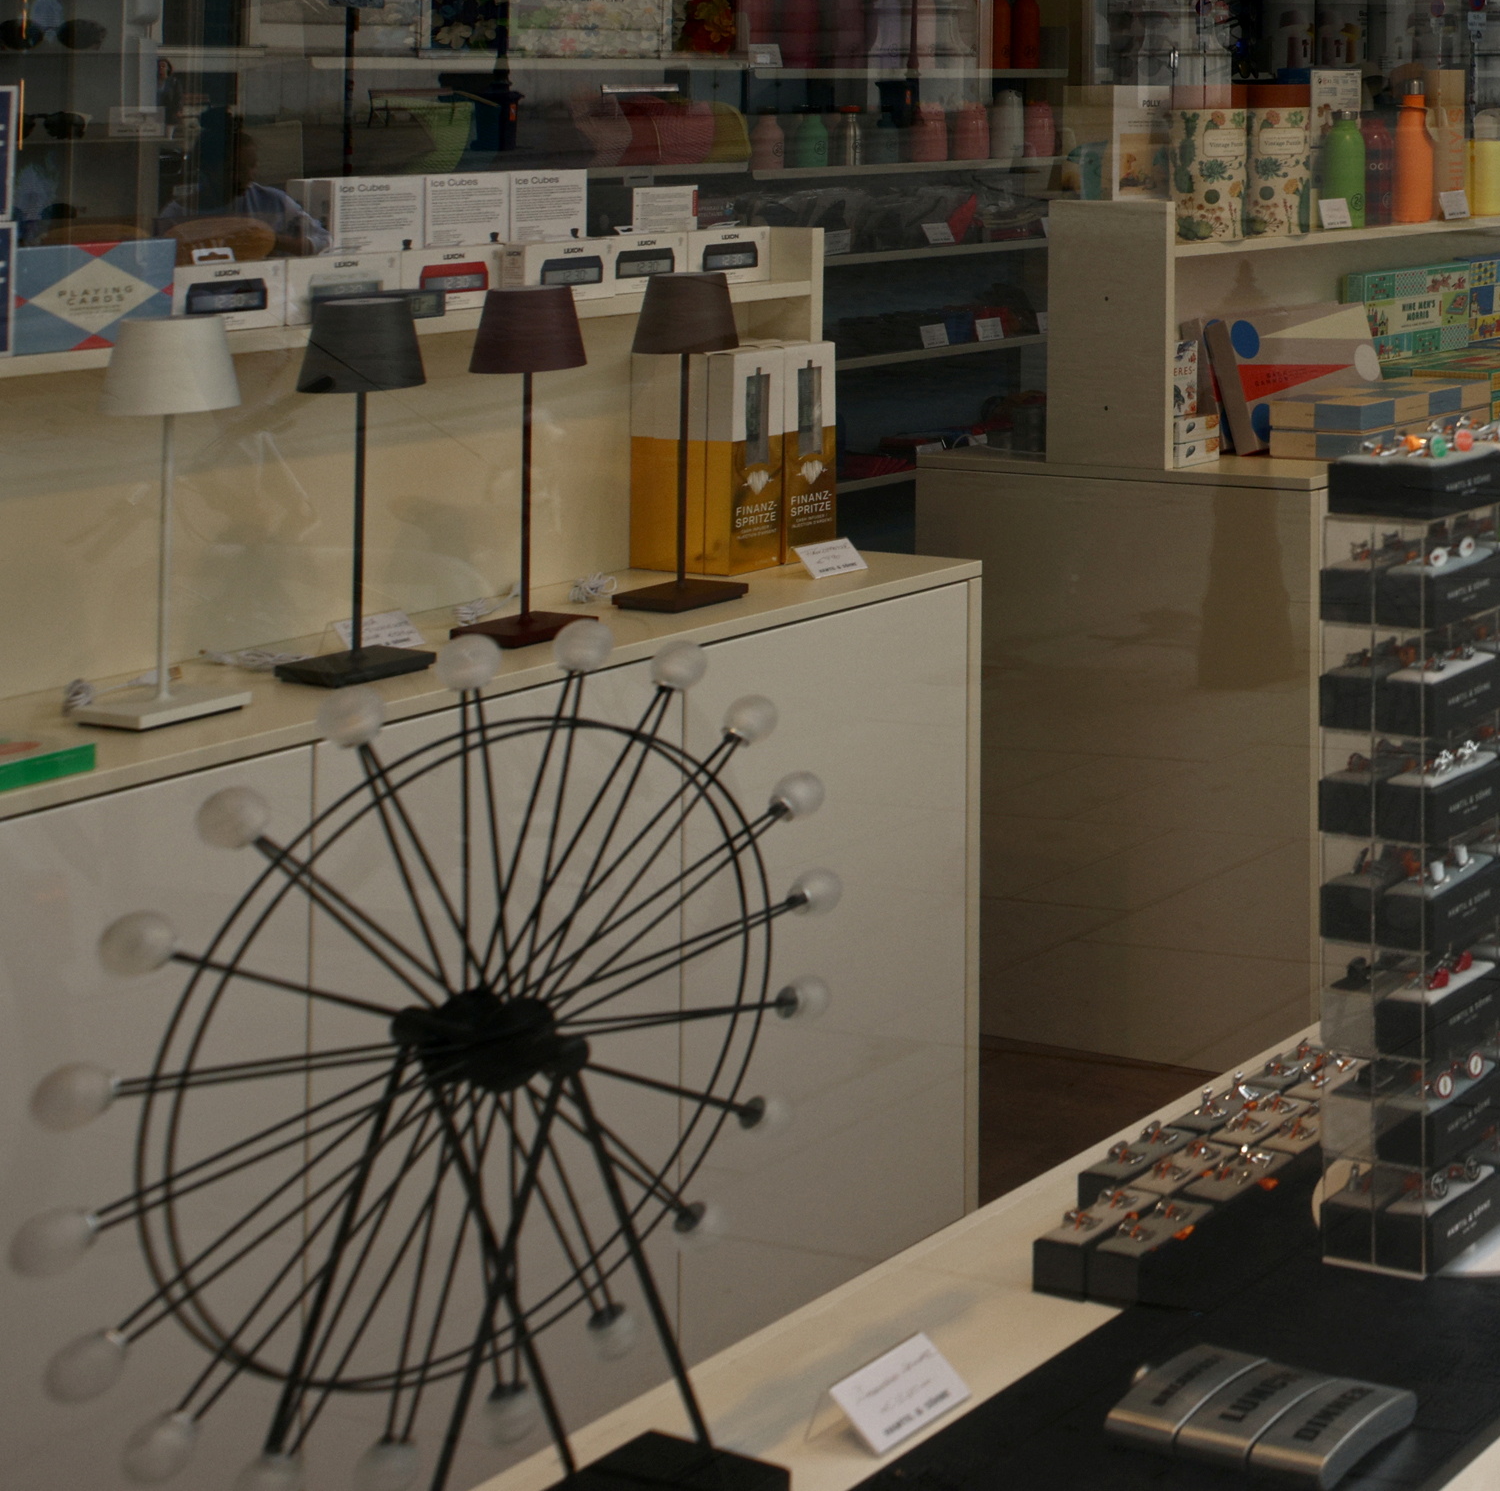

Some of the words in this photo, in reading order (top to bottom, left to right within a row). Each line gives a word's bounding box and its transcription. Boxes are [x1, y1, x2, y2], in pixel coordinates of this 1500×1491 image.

[1142, 99, 1161, 108] POLLY
[430, 179, 445, 188] Ice
[447, 177, 479, 187] Cubes
[514, 177, 529, 185] Ice
[531, 175, 560, 184] Cubes
[339, 185, 355, 193] Ice
[358, 183, 391, 193] Cubes
[58, 284, 134, 299] PLAYING
[66, 293, 126, 306] CARDS
[1402, 303, 1416, 312] NINE
[1406, 310, 1429, 322] MORRIS
[1173, 365, 1195, 377] ERES-
[790, 490, 833, 506] FINANZ-
[736, 500, 778, 517] FINANZ-
[790, 500, 832, 517] SPRITZE
[735, 511, 777, 528] SPRITZE
[1218, 1371, 1302, 1422] LUNCH
[1292, 1386, 1375, 1443] DINNER
